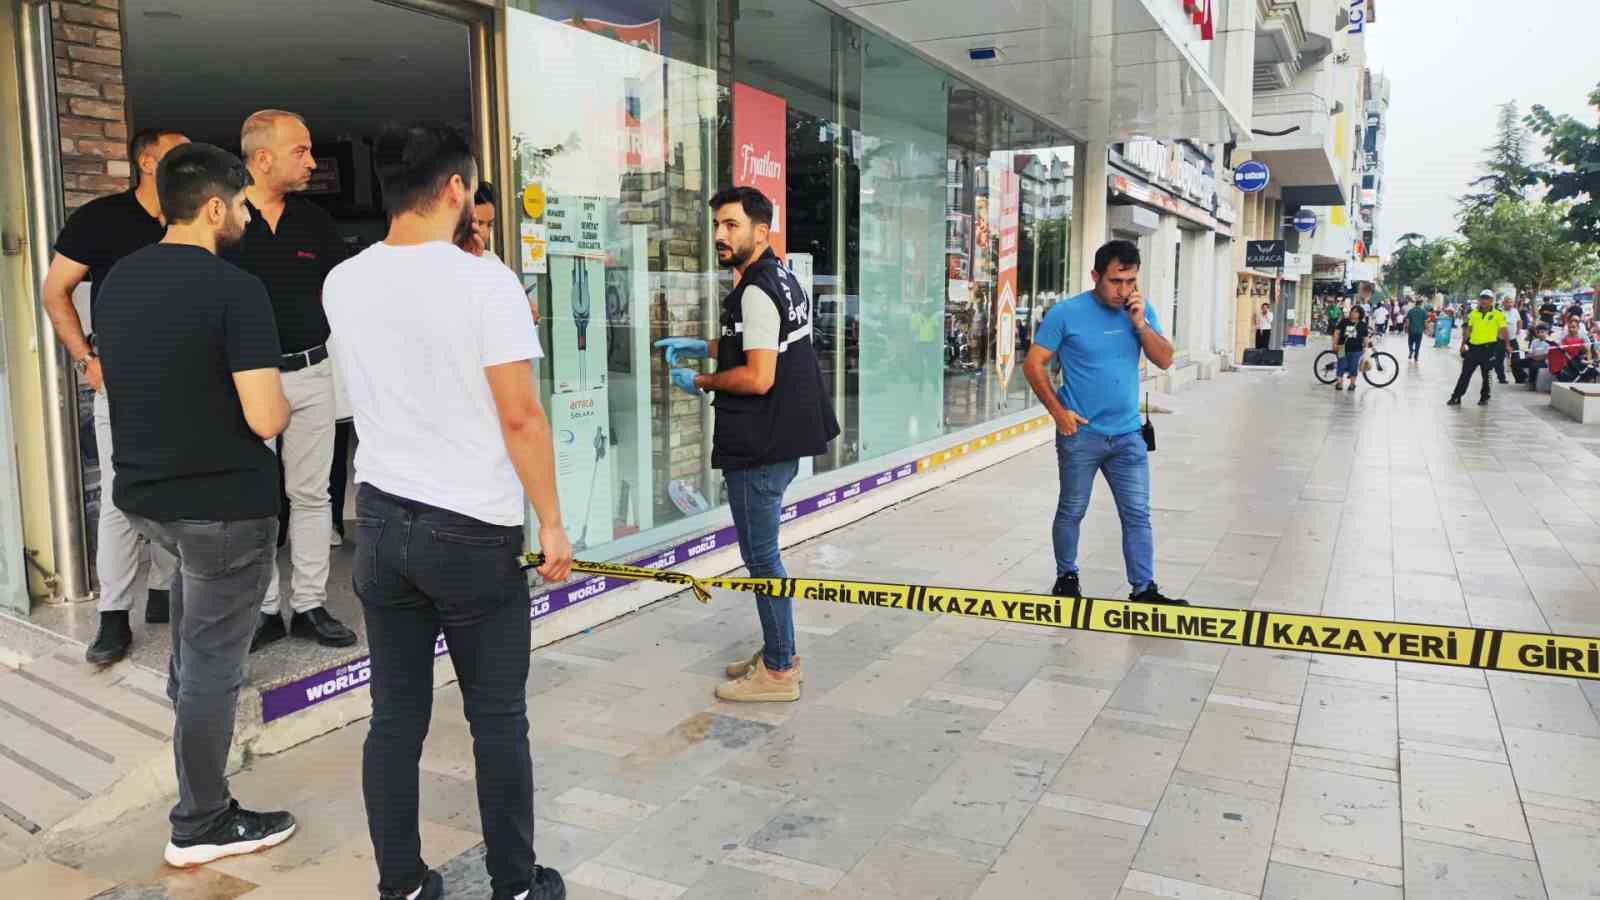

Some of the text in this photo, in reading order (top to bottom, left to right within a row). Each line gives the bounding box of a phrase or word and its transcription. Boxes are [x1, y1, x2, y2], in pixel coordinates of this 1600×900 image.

[1247, 255, 1281, 263] KARACA
[688, 540, 716, 557] WORLD
[567, 580, 607, 603] WORLD
[804, 582, 902, 609] GİRİLMEZ
[530, 603, 550, 618] RLD
[928, 594, 1062, 623] KAZA YERİ
[1103, 605, 1237, 639] GİRİLMEZ
[1272, 622, 1458, 660] KAZA YERİ
[307, 668, 371, 702] WORLD
